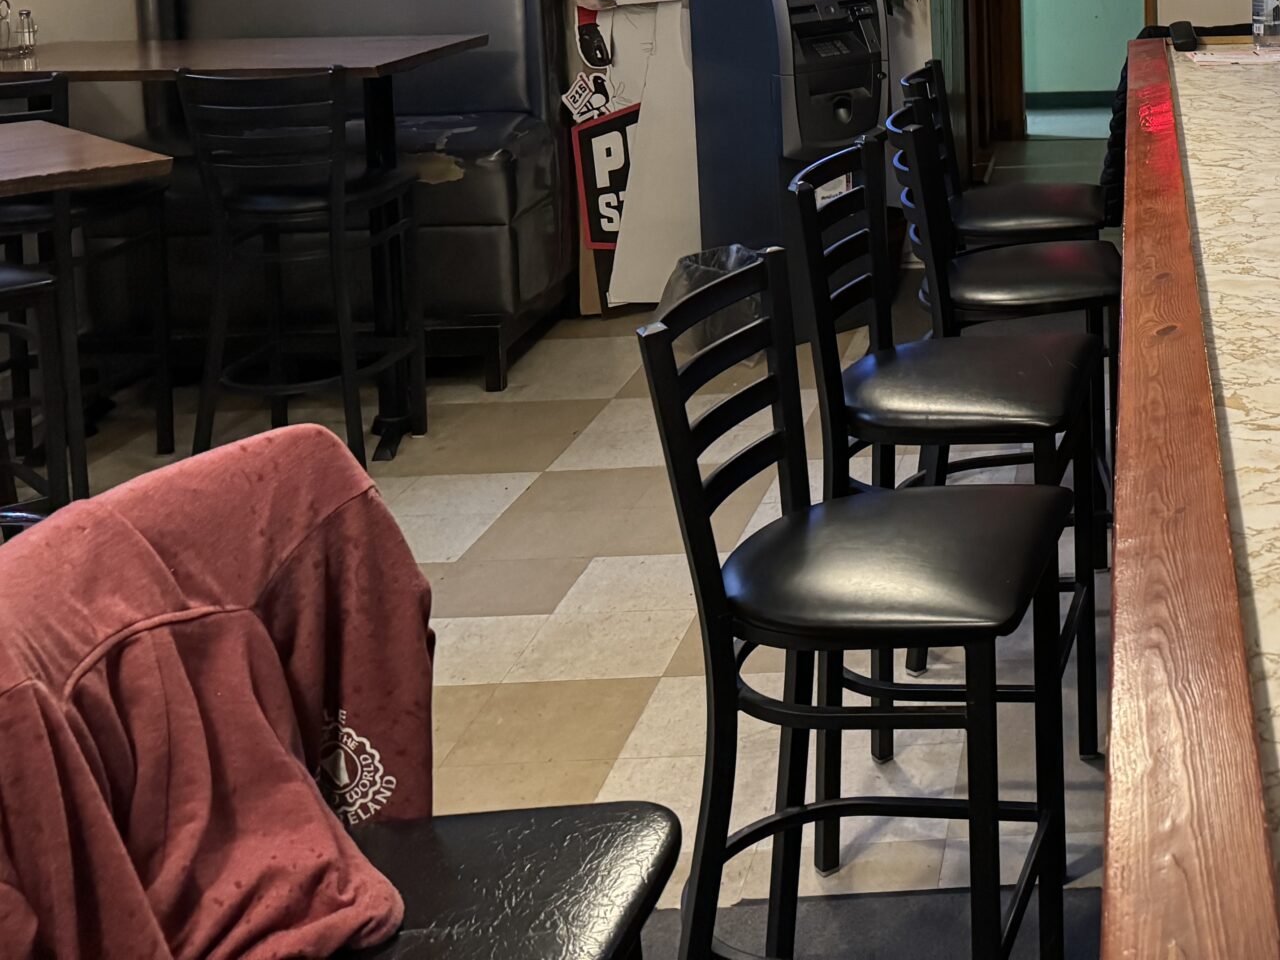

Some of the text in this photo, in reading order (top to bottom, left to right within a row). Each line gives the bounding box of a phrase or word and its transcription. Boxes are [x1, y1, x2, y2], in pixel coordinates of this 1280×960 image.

[570, 83, 588, 105] 215
[341, 733, 375, 804] HE WORLD
[346, 775, 397, 825] ELAND
